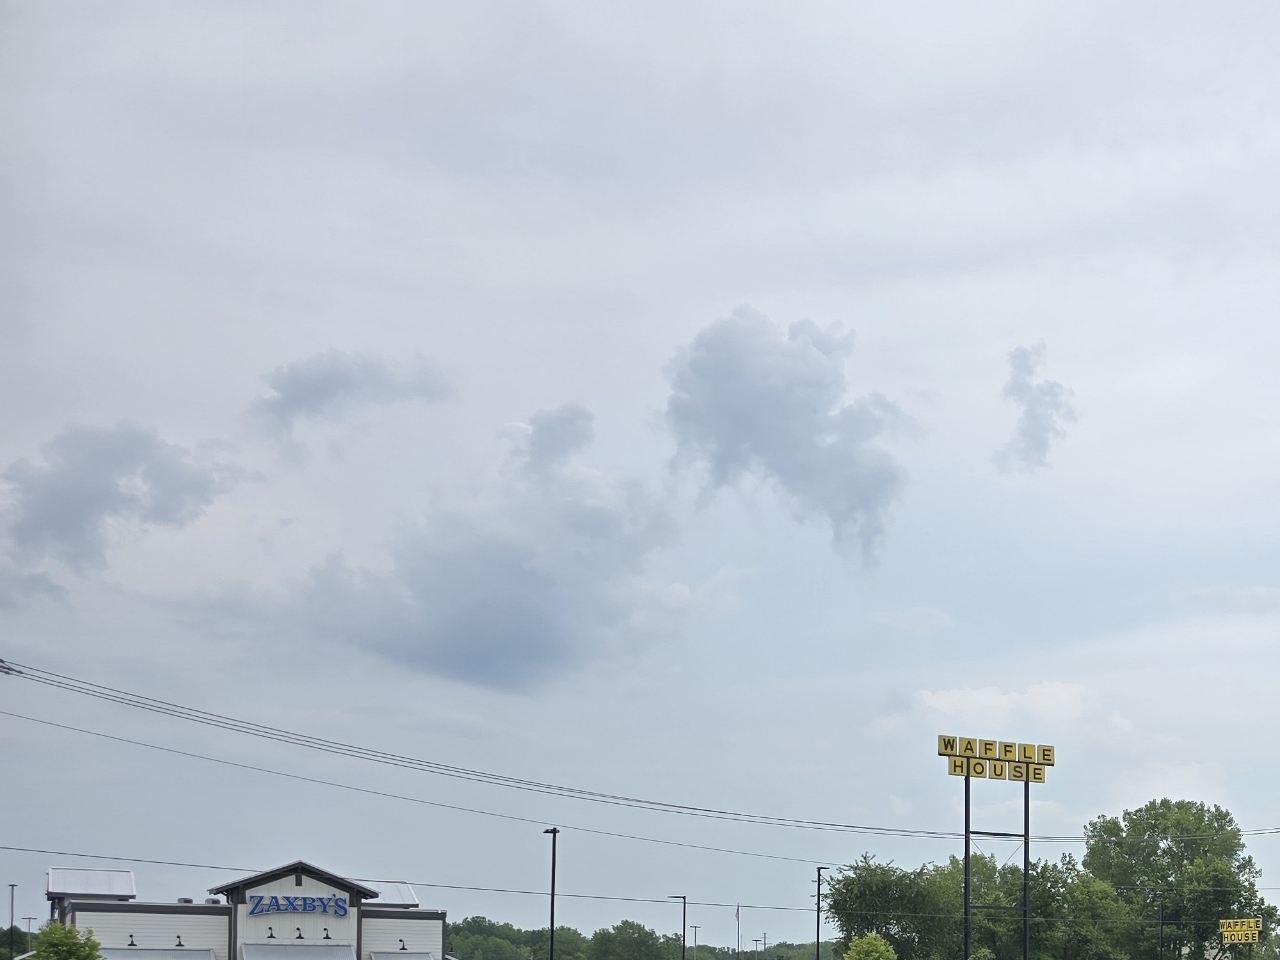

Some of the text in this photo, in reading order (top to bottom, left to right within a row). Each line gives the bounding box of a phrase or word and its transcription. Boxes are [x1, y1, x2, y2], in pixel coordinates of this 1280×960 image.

[943, 738, 1052, 762] WAFFLE
[953, 760, 1043, 781] HOUSE
[248, 893, 349, 917] ZAXBY'S
[1220, 920, 1261, 930] WAFFLE
[1223, 932, 1257, 942] HOUSE
